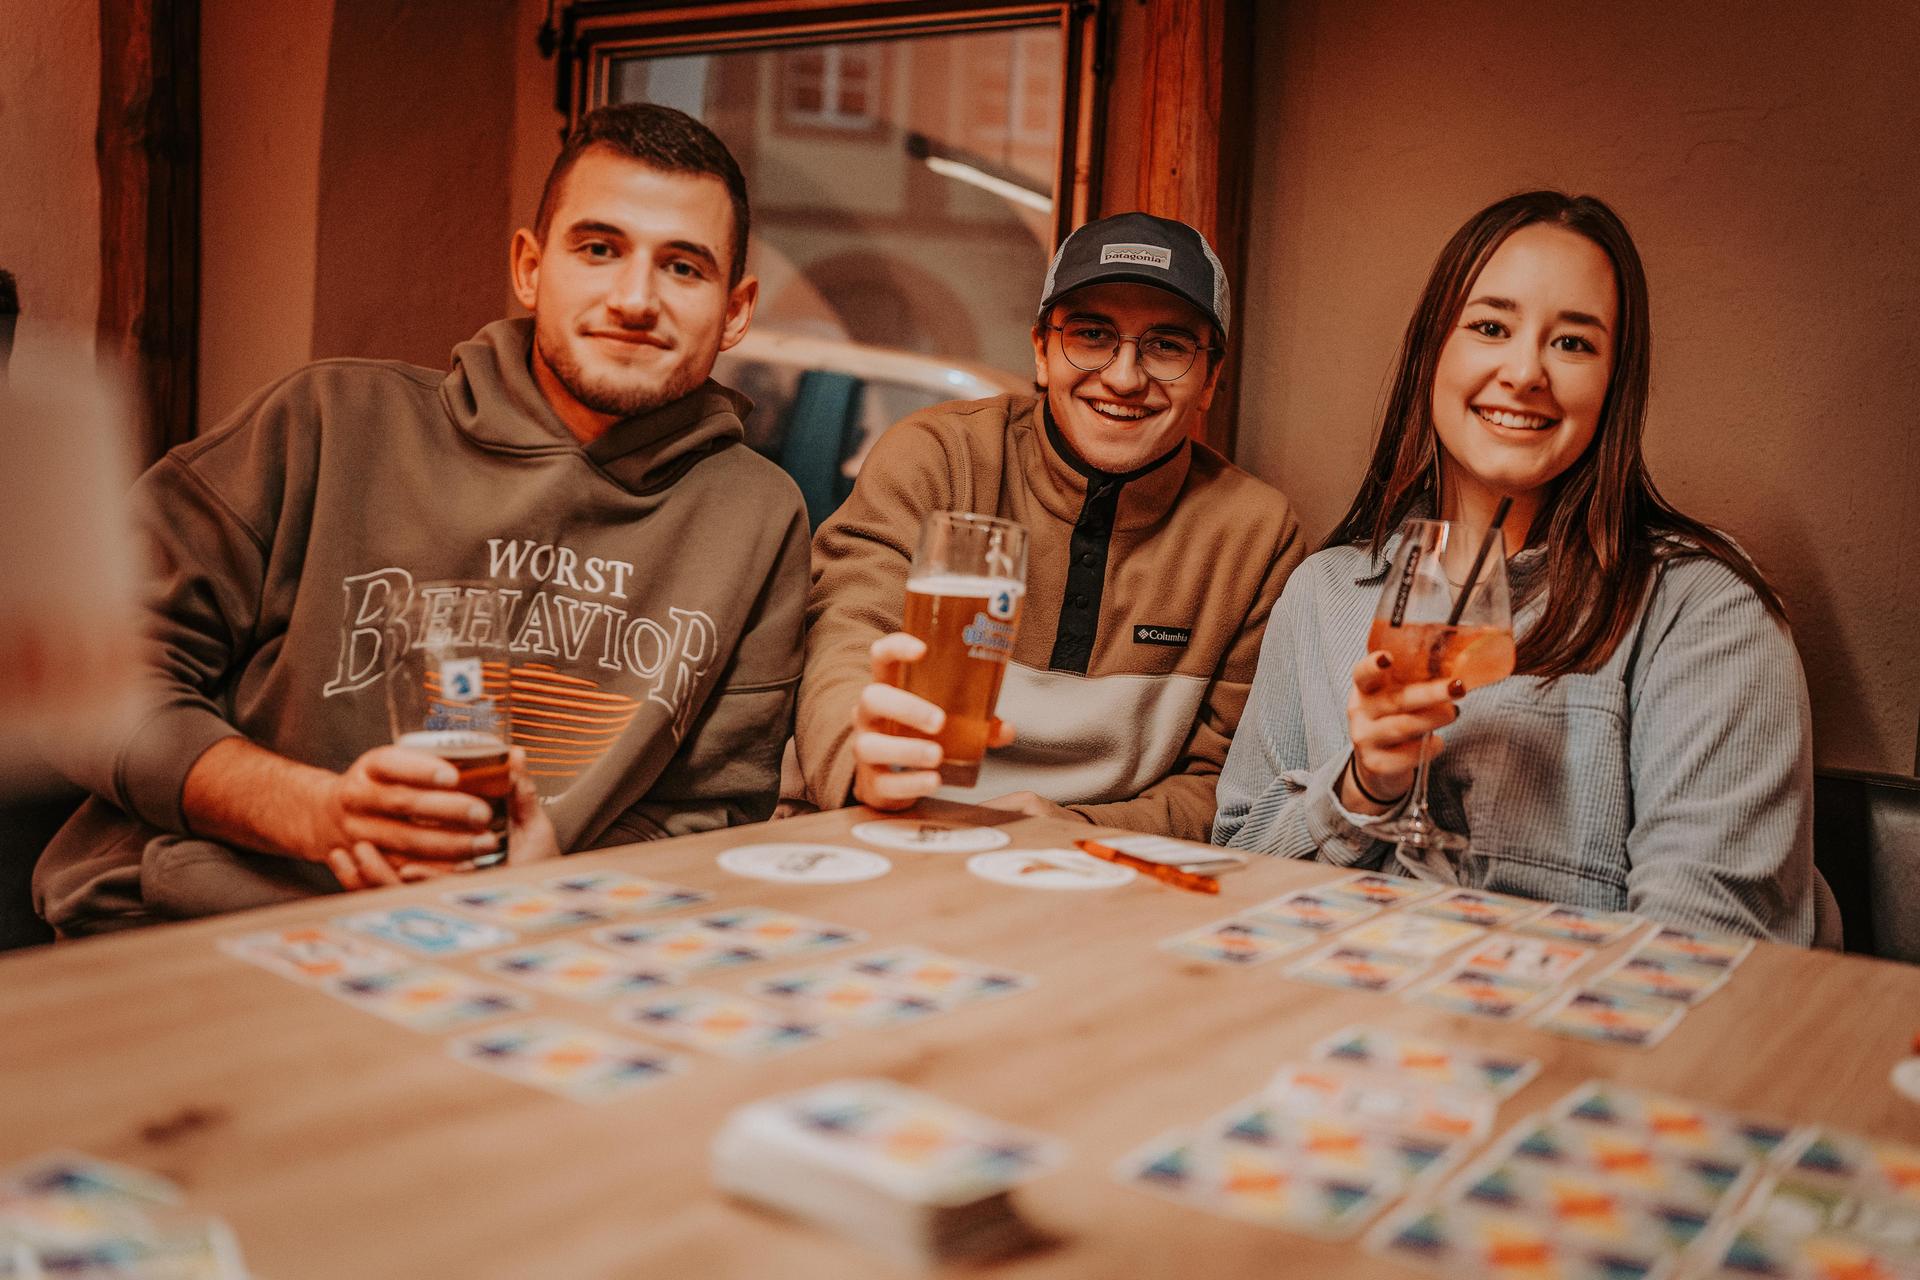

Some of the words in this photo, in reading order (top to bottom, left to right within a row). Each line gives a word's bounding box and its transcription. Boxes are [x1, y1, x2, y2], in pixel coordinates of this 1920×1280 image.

[1105, 253, 1161, 263] patagonia
[487, 538, 635, 600] WORST
[1149, 629, 1188, 642] Columbia
[323, 566, 719, 746] BEHAVIOR
